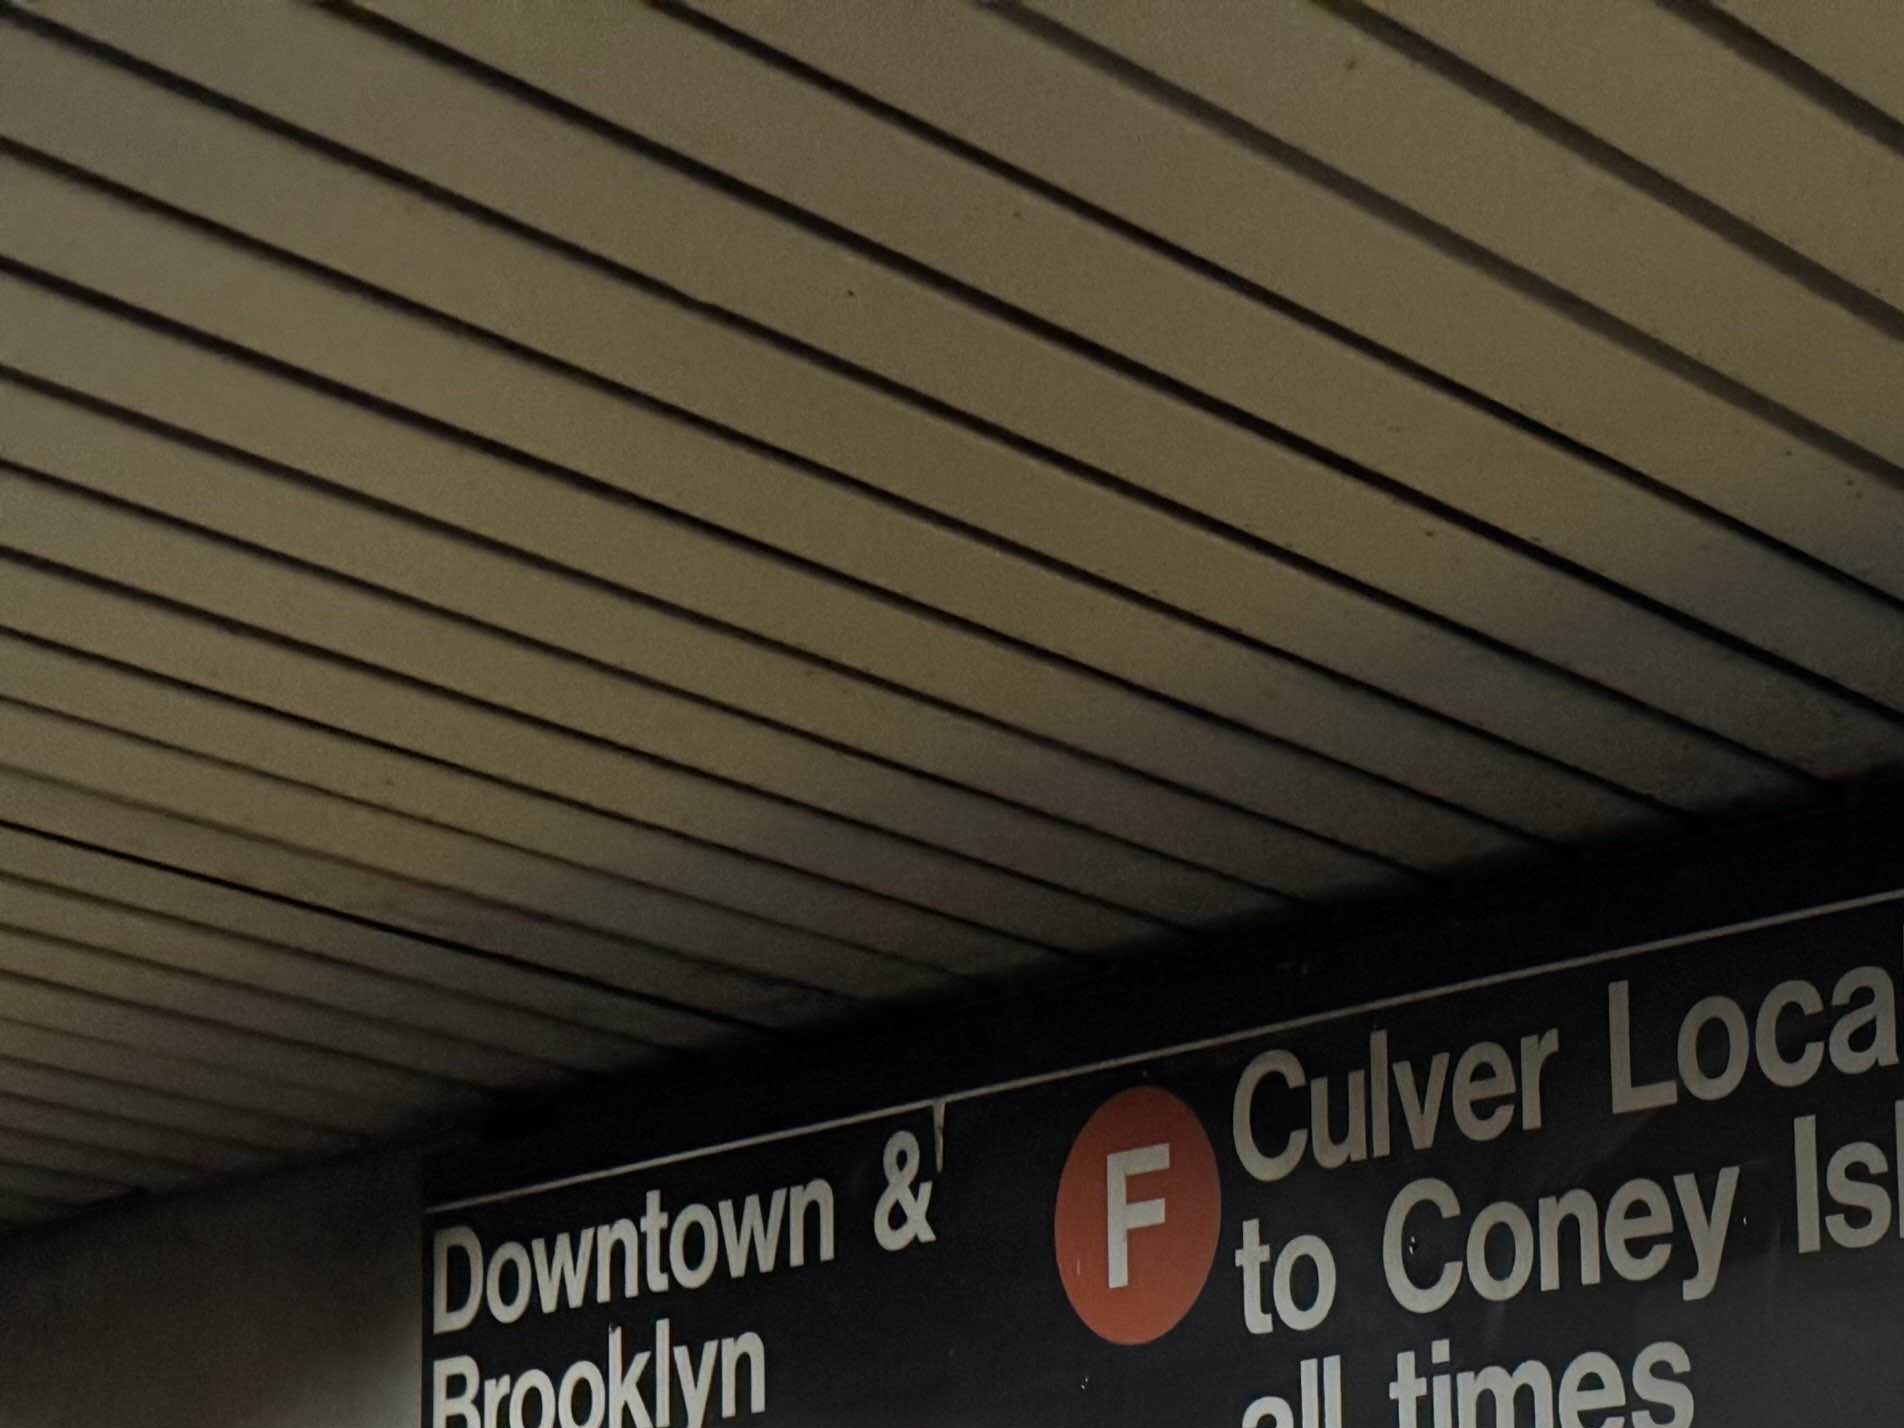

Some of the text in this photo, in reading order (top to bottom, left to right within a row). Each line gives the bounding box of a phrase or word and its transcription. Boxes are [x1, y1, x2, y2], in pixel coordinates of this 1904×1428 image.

[1233, 1027, 1558, 1182] Culver
[433, 1130, 936, 1335] Downtown &
[1107, 1143, 1170, 1288] F
[1235, 1219, 1335, 1335] to
[1383, 1166, 1740, 1314] Coney
